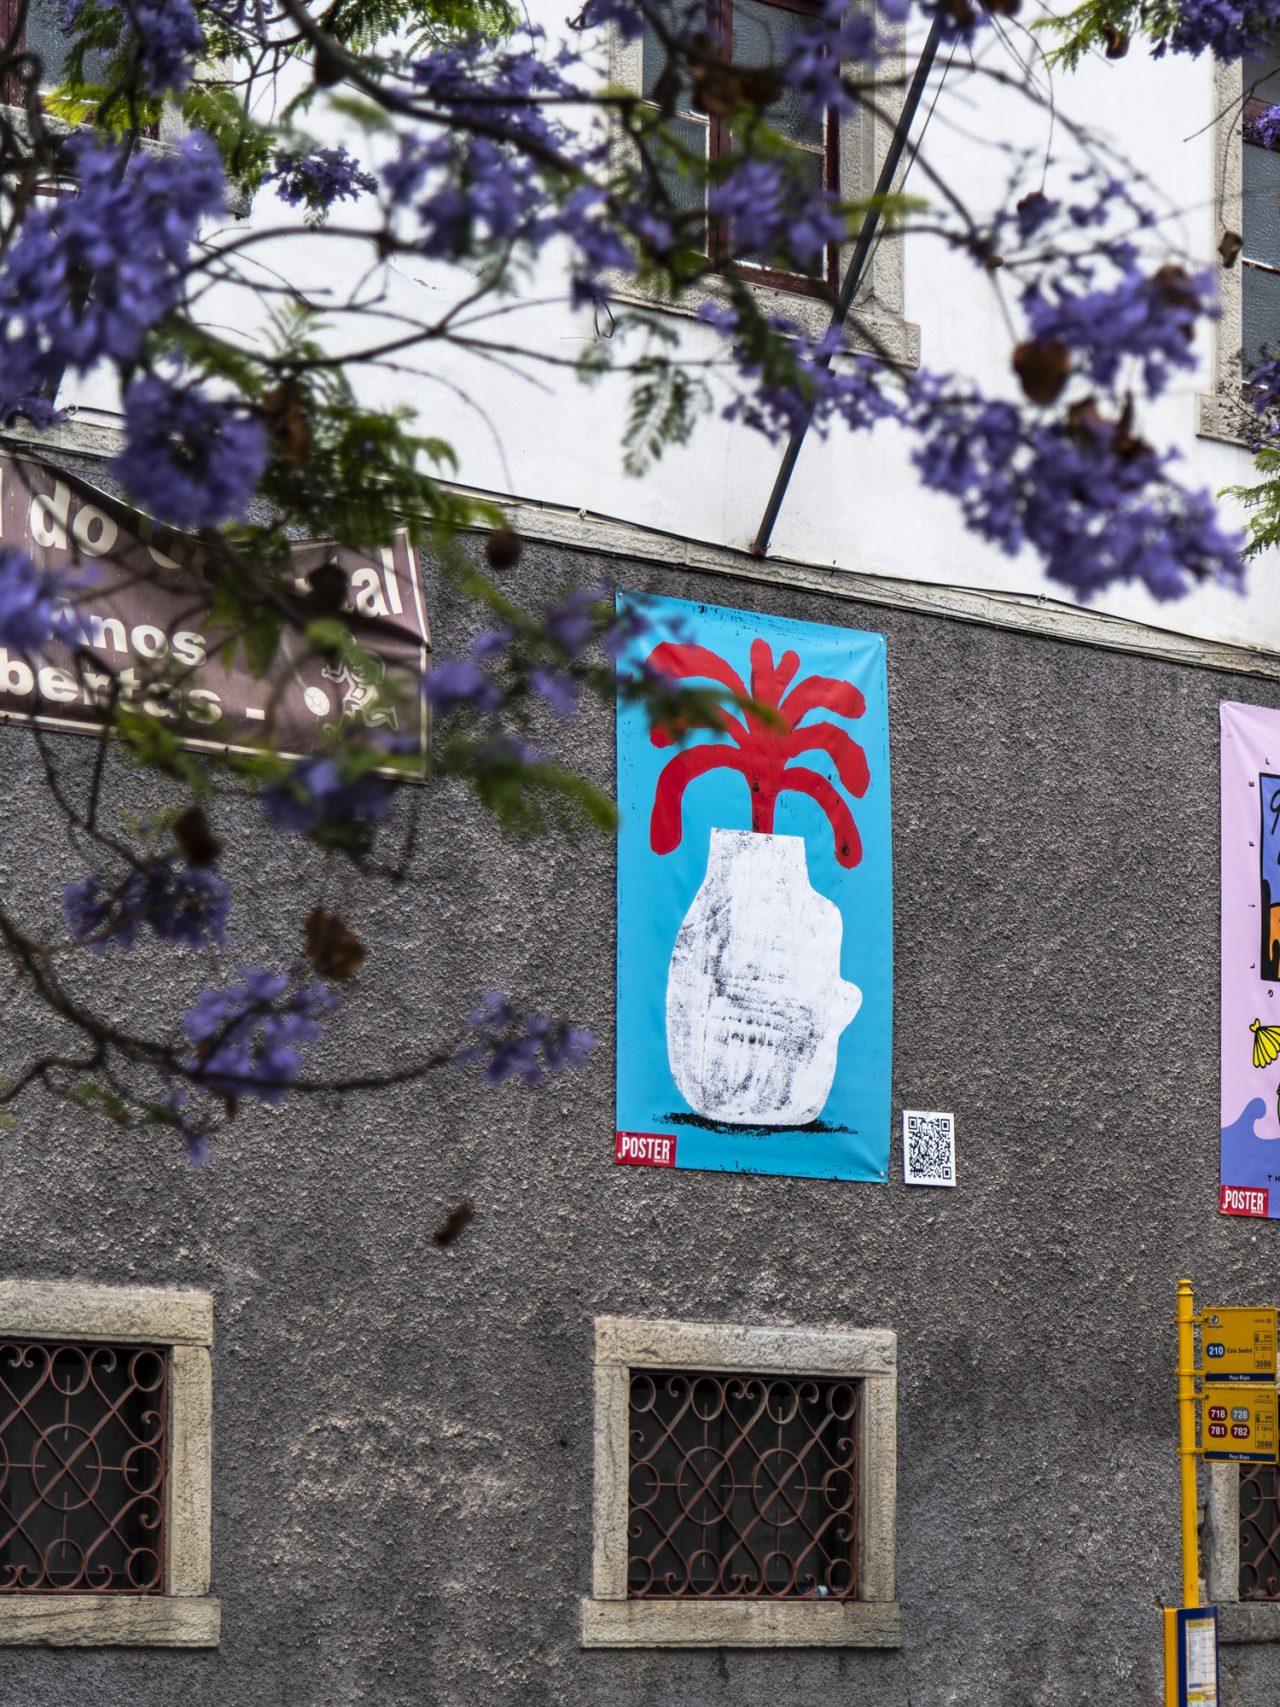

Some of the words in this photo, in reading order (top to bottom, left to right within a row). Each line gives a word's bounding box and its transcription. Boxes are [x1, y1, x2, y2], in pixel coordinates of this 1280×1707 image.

[30, 479, 118, 557] do
[622, 1137, 670, 1160] POSTER
[1225, 1190, 1264, 1211] POSTER
[1209, 1346, 1224, 1355] 210
[1211, 1410, 1225, 1418] 718
[1233, 1411, 1248, 1419] 728
[1211, 1426, 1225, 1435] 781
[1233, 1427, 1248, 1436] 782
